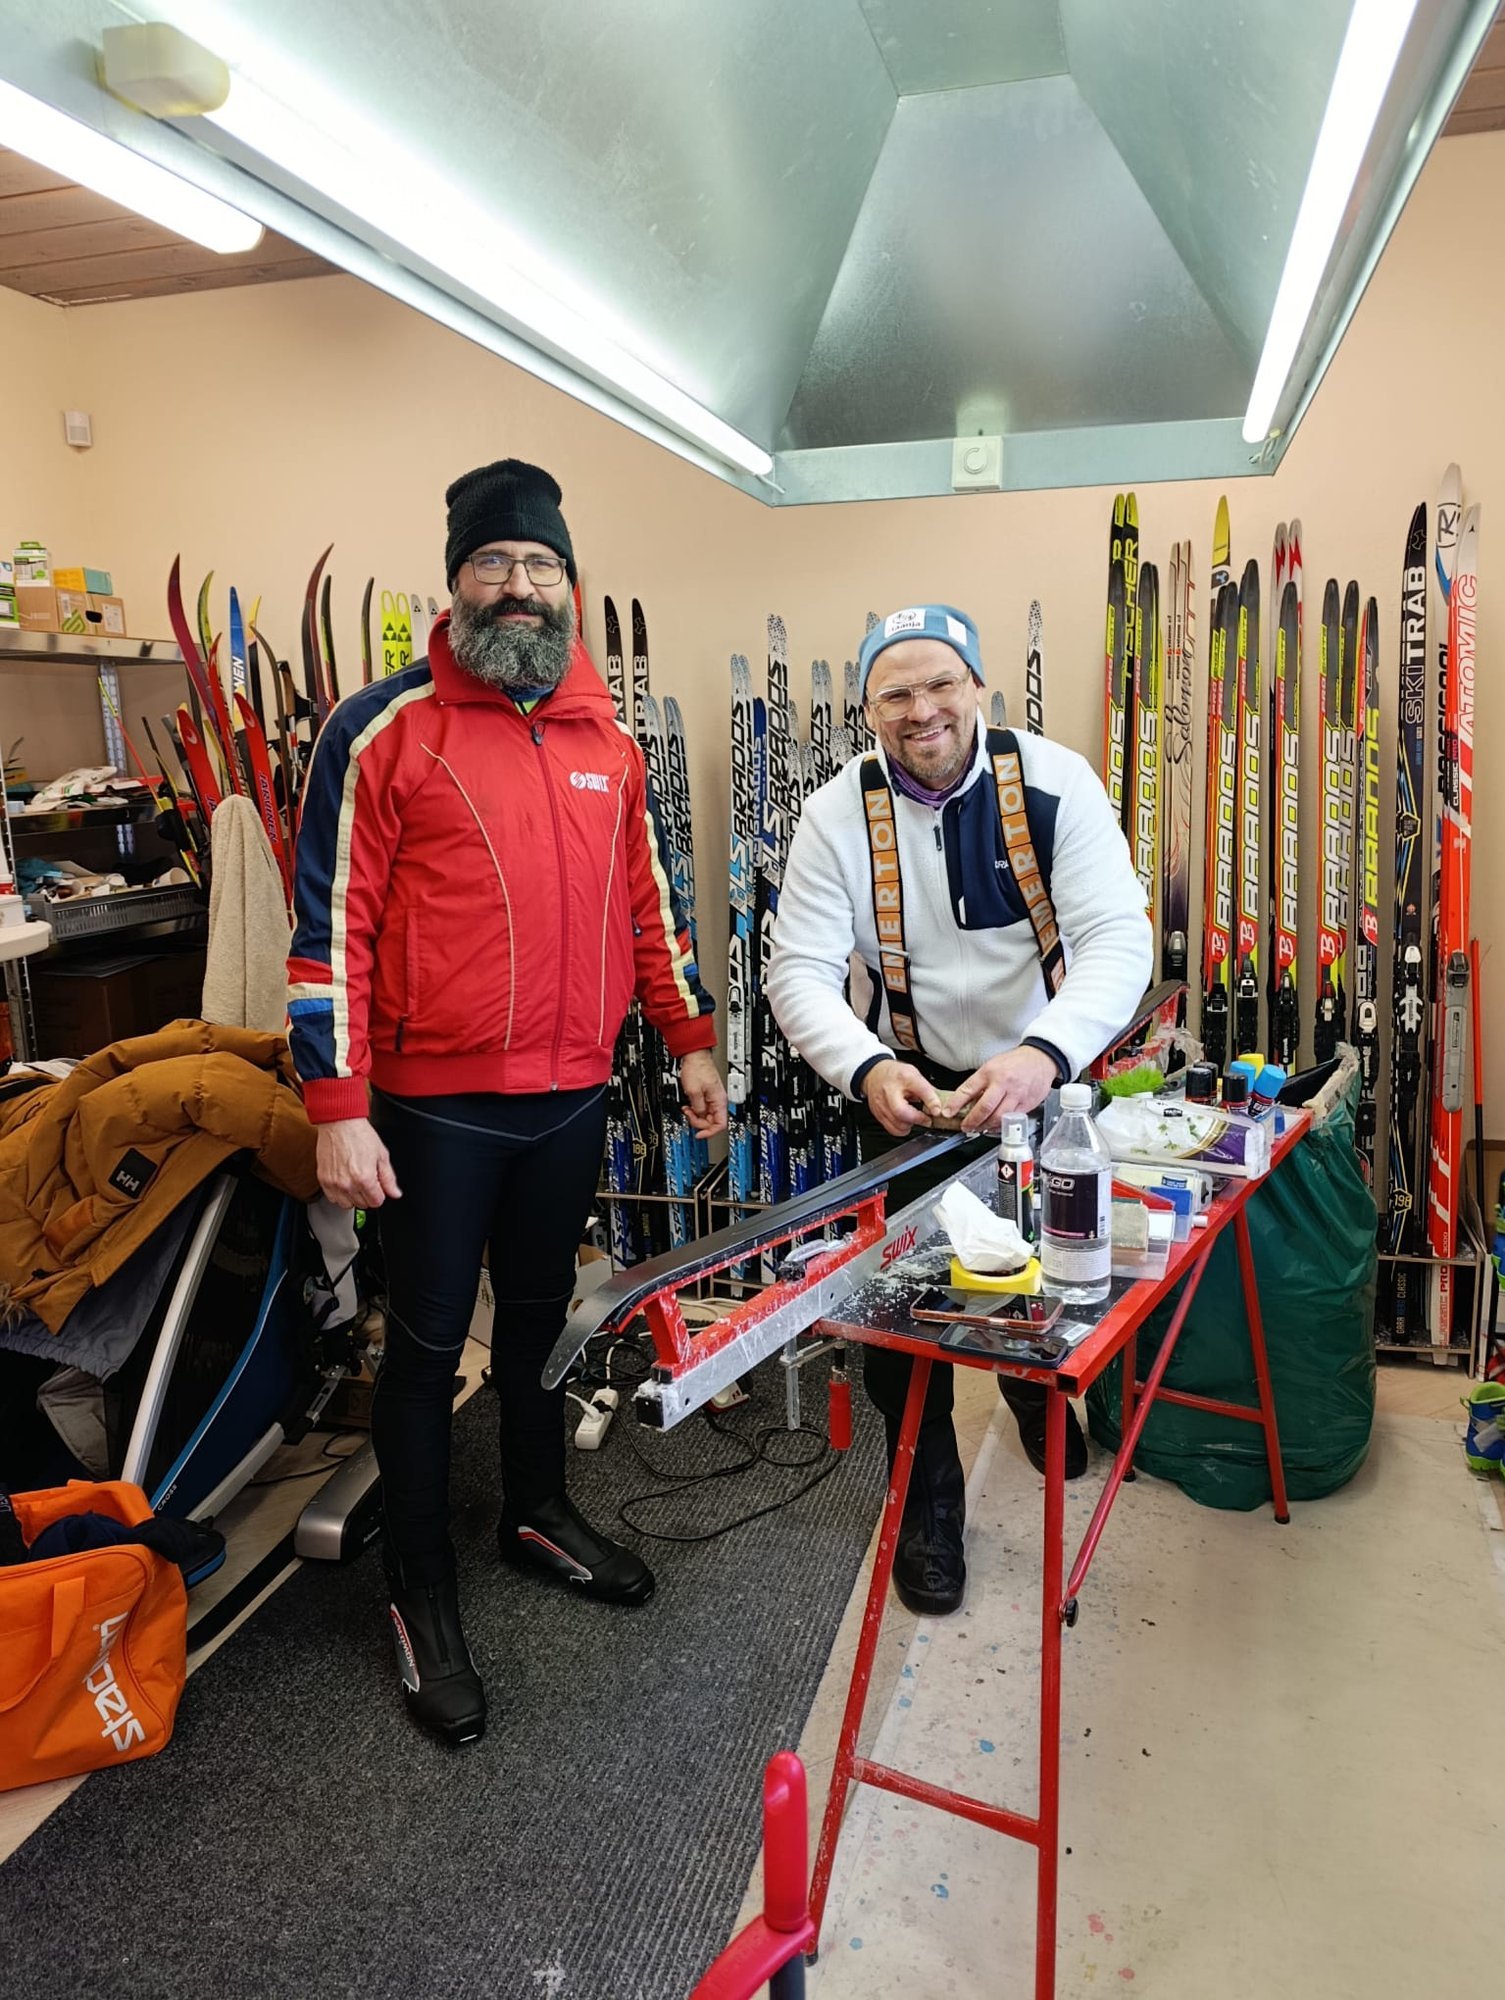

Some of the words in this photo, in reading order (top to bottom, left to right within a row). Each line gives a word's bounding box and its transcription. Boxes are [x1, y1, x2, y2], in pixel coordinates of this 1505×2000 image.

[1125, 538, 1138, 680] FISCHER
[1458, 574, 1476, 738] ATOMIC
[668, 733, 690, 857] BRADOS
[731, 700, 746, 841] BRADOS
[768, 659, 784, 809] BRADOS
[996, 755, 1057, 951] EMERTON
[1215, 730, 1236, 927] BRADOS
[1242, 714, 1260, 918] BRADOS
[1283, 732, 1299, 929] BRADOS
[1324, 728, 1341, 931] BRADOS
[869, 793, 908, 991] EMERTON
[116, 1170, 141, 1192] HH
[760, 1126, 769, 1160] 180
[1394, 1194, 1412, 1209] 198
[1440, 1264, 1449, 1293] PRO
